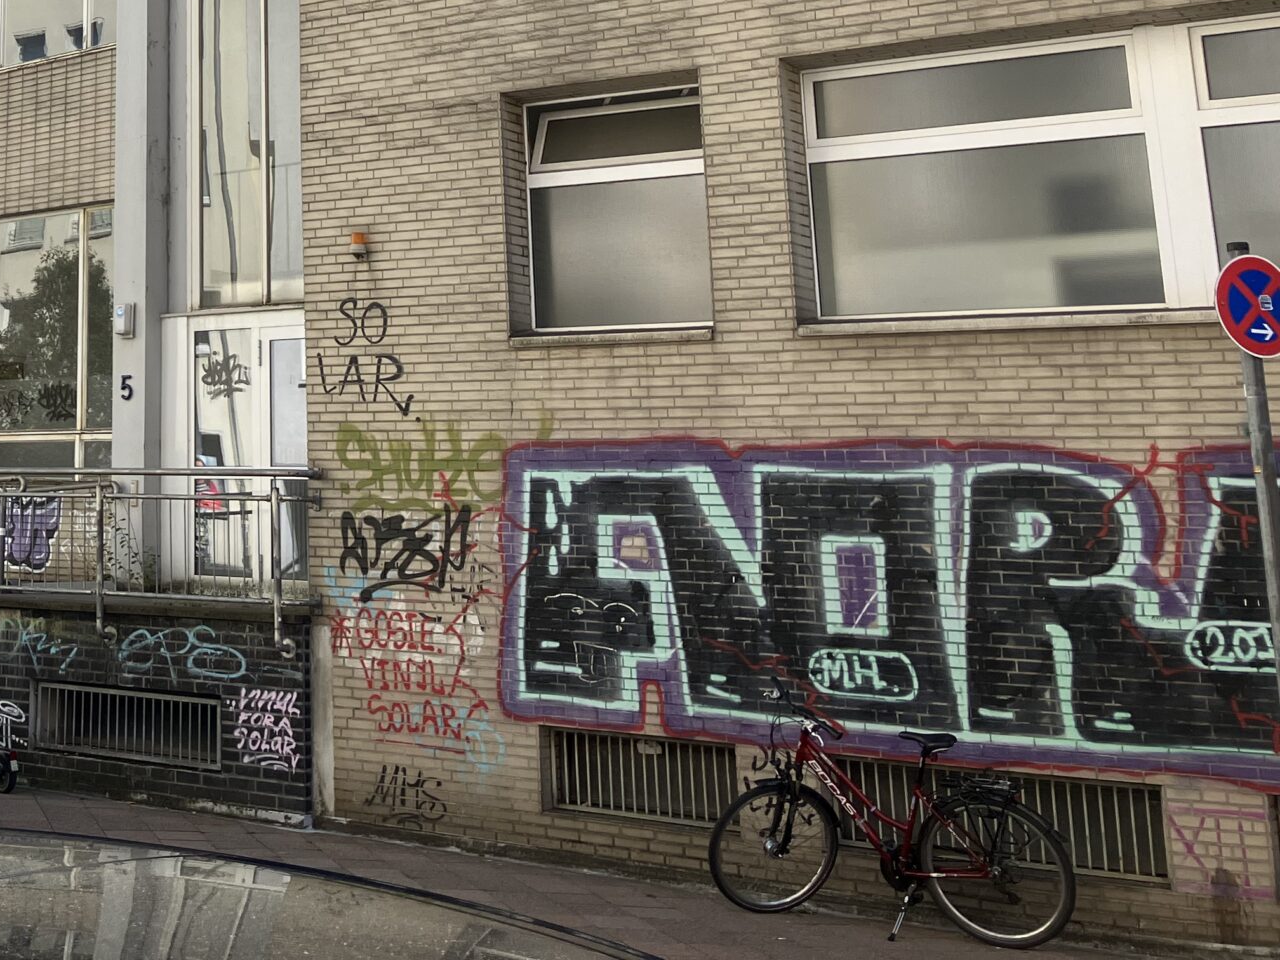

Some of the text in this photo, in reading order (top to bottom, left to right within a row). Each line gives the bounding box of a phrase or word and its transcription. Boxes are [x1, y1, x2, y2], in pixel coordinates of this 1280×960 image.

[334, 297, 388, 346] SO
[121, 375, 133, 401] 5
[808, 759, 857, 815] BOCAS
